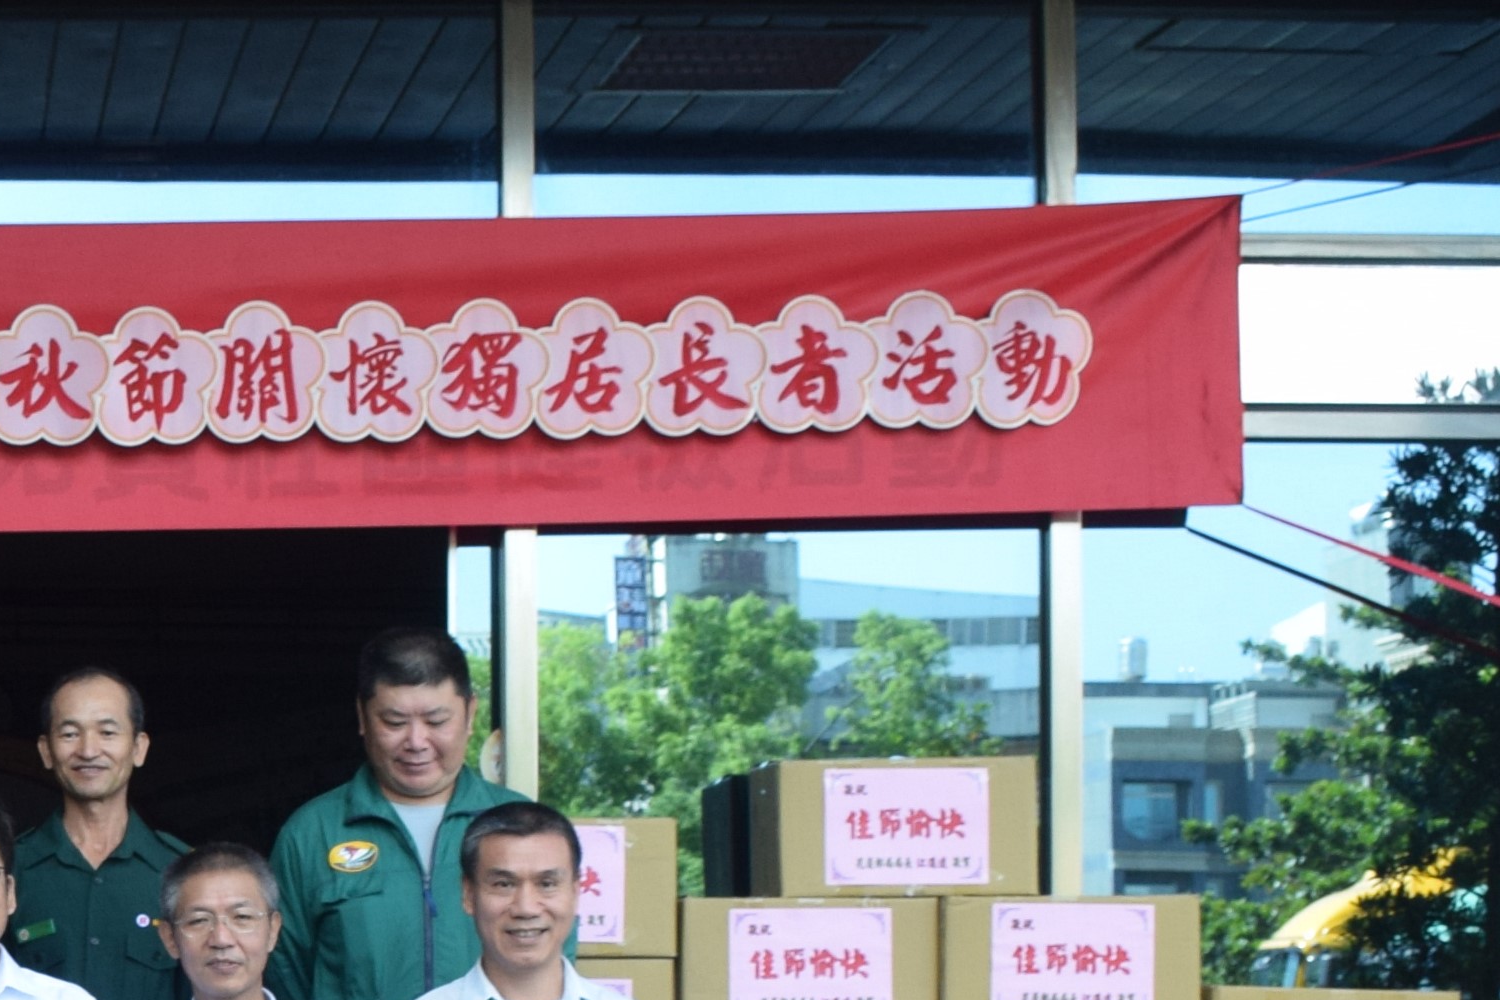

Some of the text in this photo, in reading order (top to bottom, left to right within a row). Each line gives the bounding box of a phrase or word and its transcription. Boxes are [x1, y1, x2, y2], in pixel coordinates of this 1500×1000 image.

[845, 808, 967, 840] 佳節愉快
[750, 948, 870, 980] 佳節愉快
[1012, 942, 1132, 976] 佳節愉快
